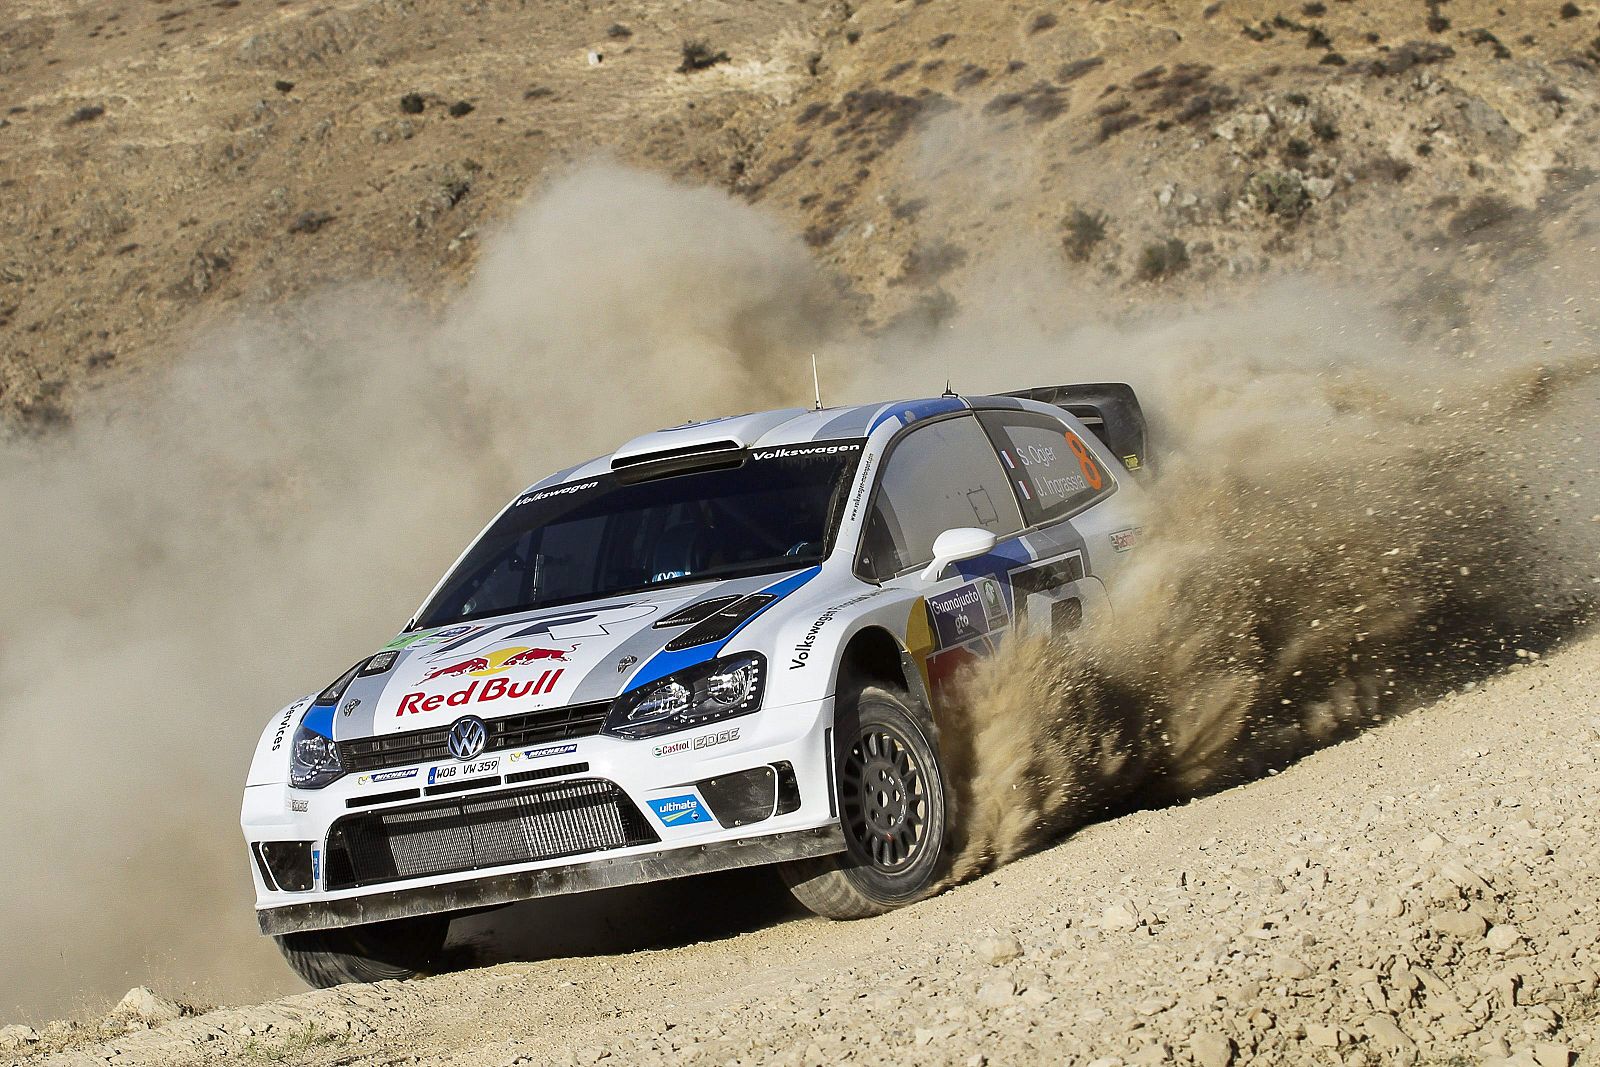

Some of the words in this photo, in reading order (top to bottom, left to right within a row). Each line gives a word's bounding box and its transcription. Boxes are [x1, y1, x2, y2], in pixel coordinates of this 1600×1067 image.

[752, 444, 860, 460] Volkswagen
[1016, 447, 1033, 466] S.
[1028, 444, 1057, 467] Ogier
[1065, 431, 1102, 490] 8
[515, 481, 599, 507] Volkswagen
[1035, 477, 1047, 497] J.
[1043, 471, 1087, 498] Ingrassia
[931, 590, 979, 615] Guanajuato
[955, 614, 970, 635] gto
[788, 606, 838, 671] Volkswagen
[396, 680, 479, 717] Red
[477, 668, 565, 703] Bull
[271, 702, 304, 752] Services
[528, 744, 577, 759] MICHELIN
[661, 740, 690, 755] Castrol
[693, 727, 741, 751] EDGE
[373, 768, 418, 781] MICHELIN
[436, 766, 457, 779] WOB
[463, 763, 477, 775] VW
[477, 760, 498, 773] 359
[659, 800, 697, 812] ultimate
